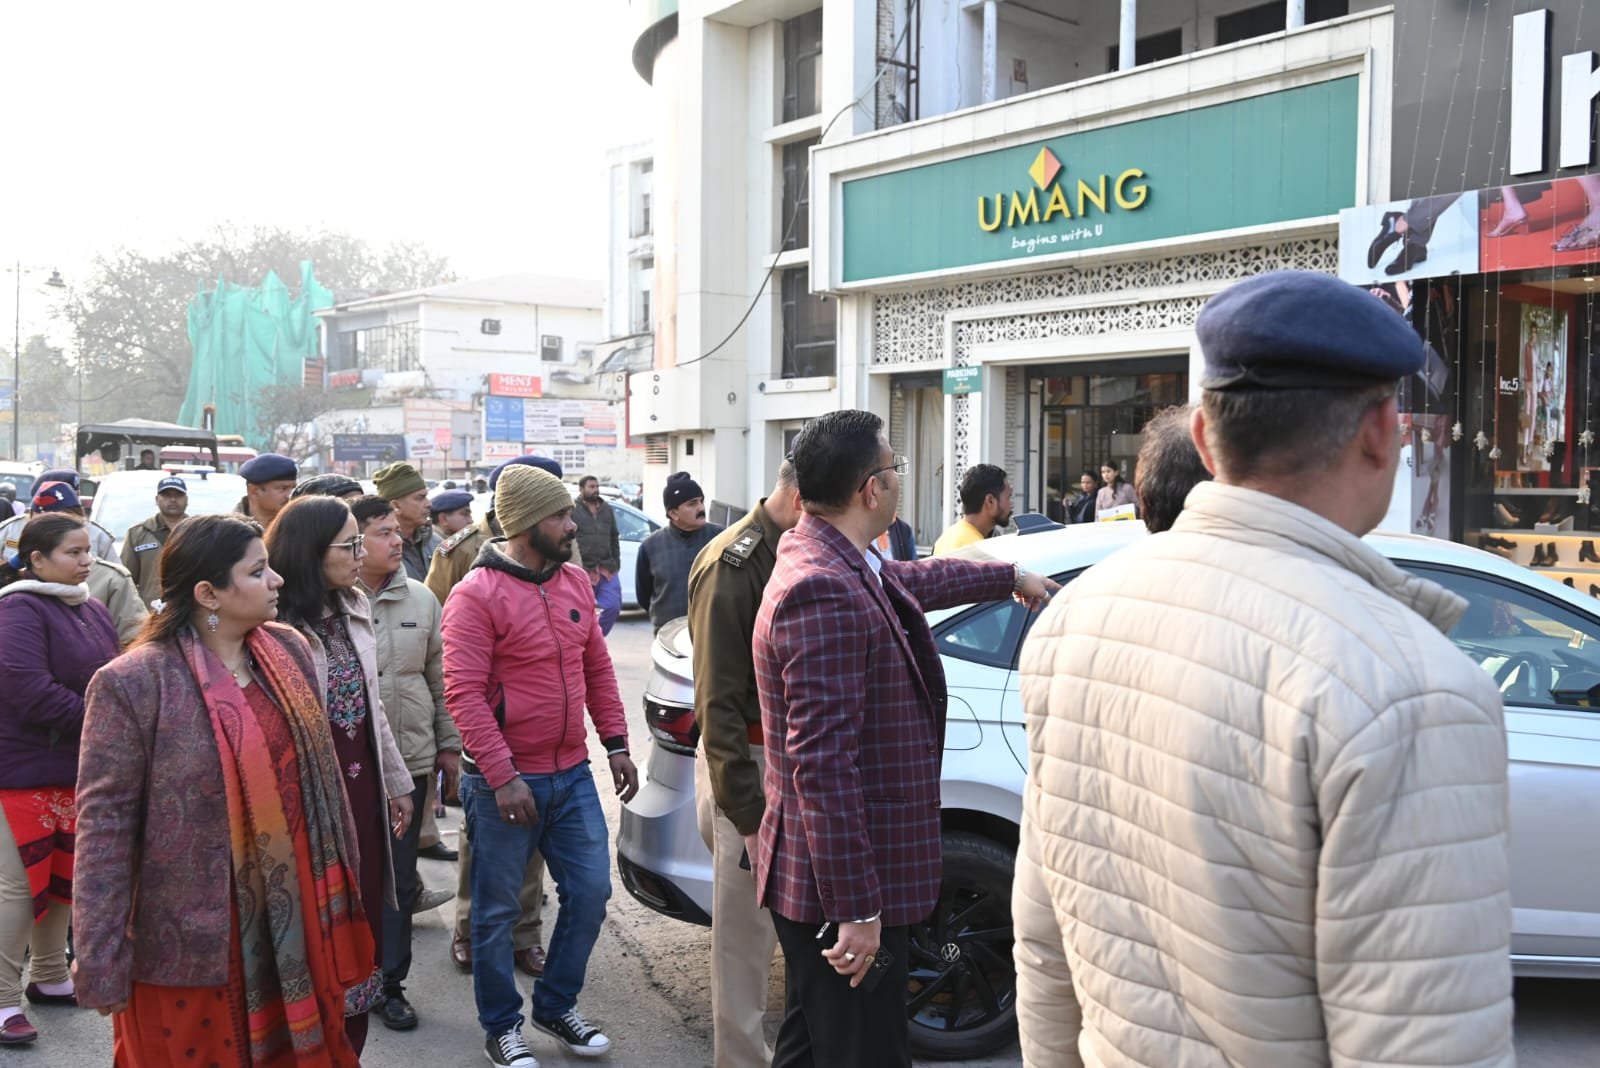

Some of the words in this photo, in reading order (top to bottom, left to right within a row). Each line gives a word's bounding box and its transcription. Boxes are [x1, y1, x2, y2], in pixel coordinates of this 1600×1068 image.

[978, 168, 1148, 232] UMANG
[1011, 233, 1058, 253] begins
[1061, 227, 1093, 242] with
[1095, 224, 1103, 236] U
[947, 368, 978, 379] PARKING
